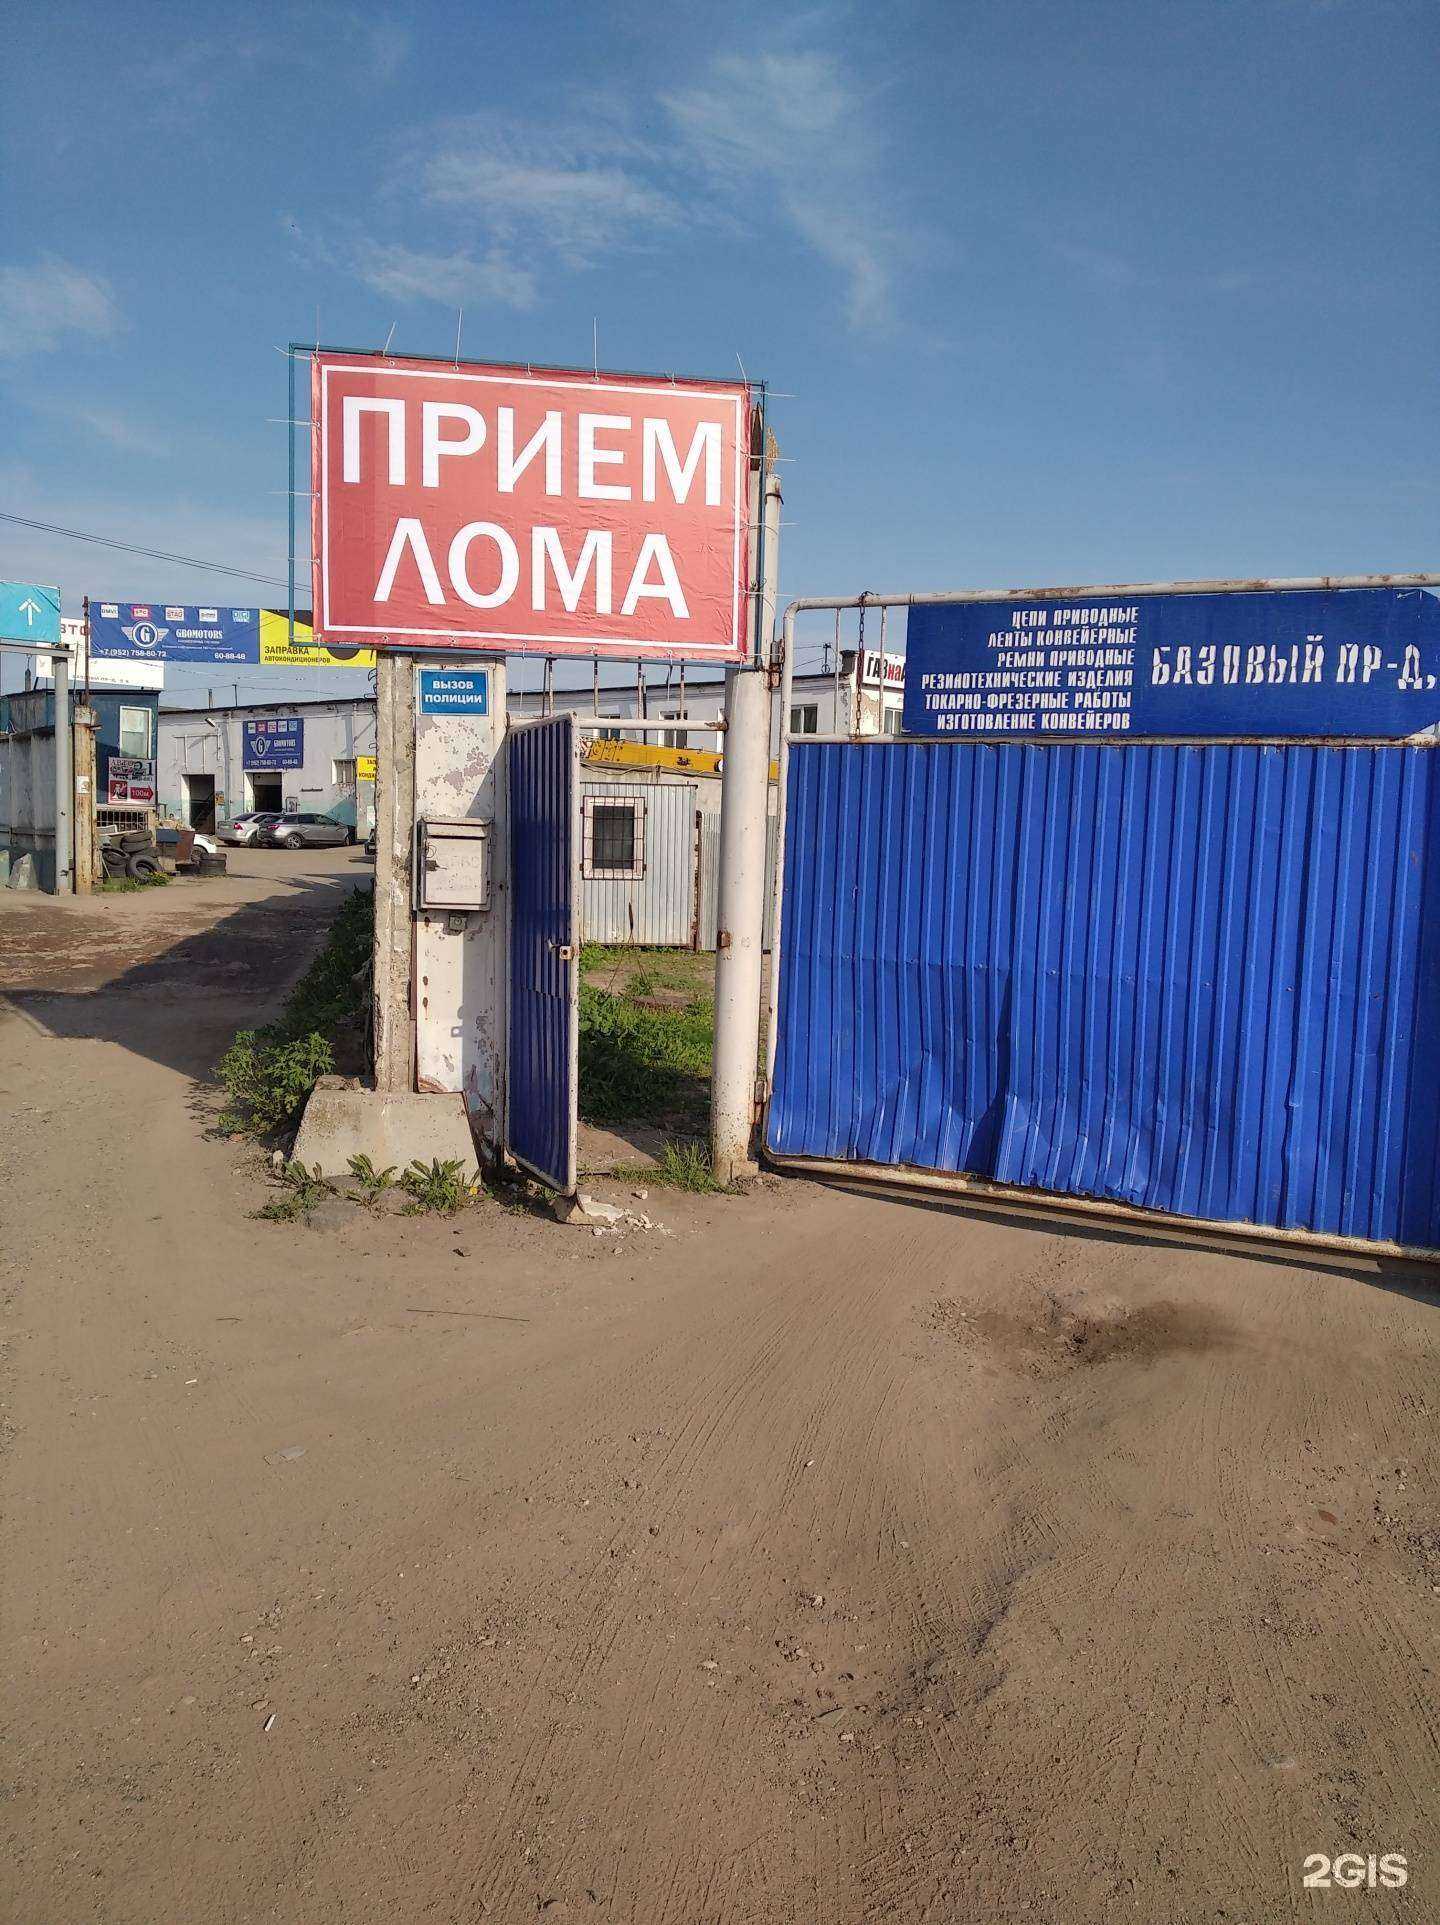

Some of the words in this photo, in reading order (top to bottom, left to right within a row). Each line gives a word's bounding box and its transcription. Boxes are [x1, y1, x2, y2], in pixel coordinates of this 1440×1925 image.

[343, 396, 722, 506] ПРИЕМ
[373, 517, 691, 619] ЛОМА
[1012, 610, 1047, 628] ЦЕПИ
[1053, 606, 1140, 627] ПРИВОДНЫЕ
[988, 631, 1032, 648] ЛЕНТЫ
[1036, 626, 1138, 646] КОНВЕЙЕРНЫЕ
[264, 645, 309, 655] ЗАПРАВКА
[264, 655, 331, 664] АВТОКОНДИЦИОНЕРОВ
[997, 651, 1045, 668] РЕМНИ
[1049, 648, 1135, 668] ПРИВОДНЫЕ
[1151, 635, 1325, 684] БАЗОВЫЙ
[1336, 643, 1436, 690] ПР-Д,
[922, 671, 1062, 690] РЕЗИНОТЕХНИЧЕСКИЕ
[1068, 669, 1133, 690] ИЗДЕЛИЯ
[925, 692, 1069, 710] ТОКАРНО-ФРЕЗЕРНЫЕ
[1074, 690, 1132, 709] РАБОТЫ
[937, 713, 1036, 730] ИЗГОТОВЛЕНИЕ
[1041, 710, 1130, 730] КОНВЕЙЕРОВ
